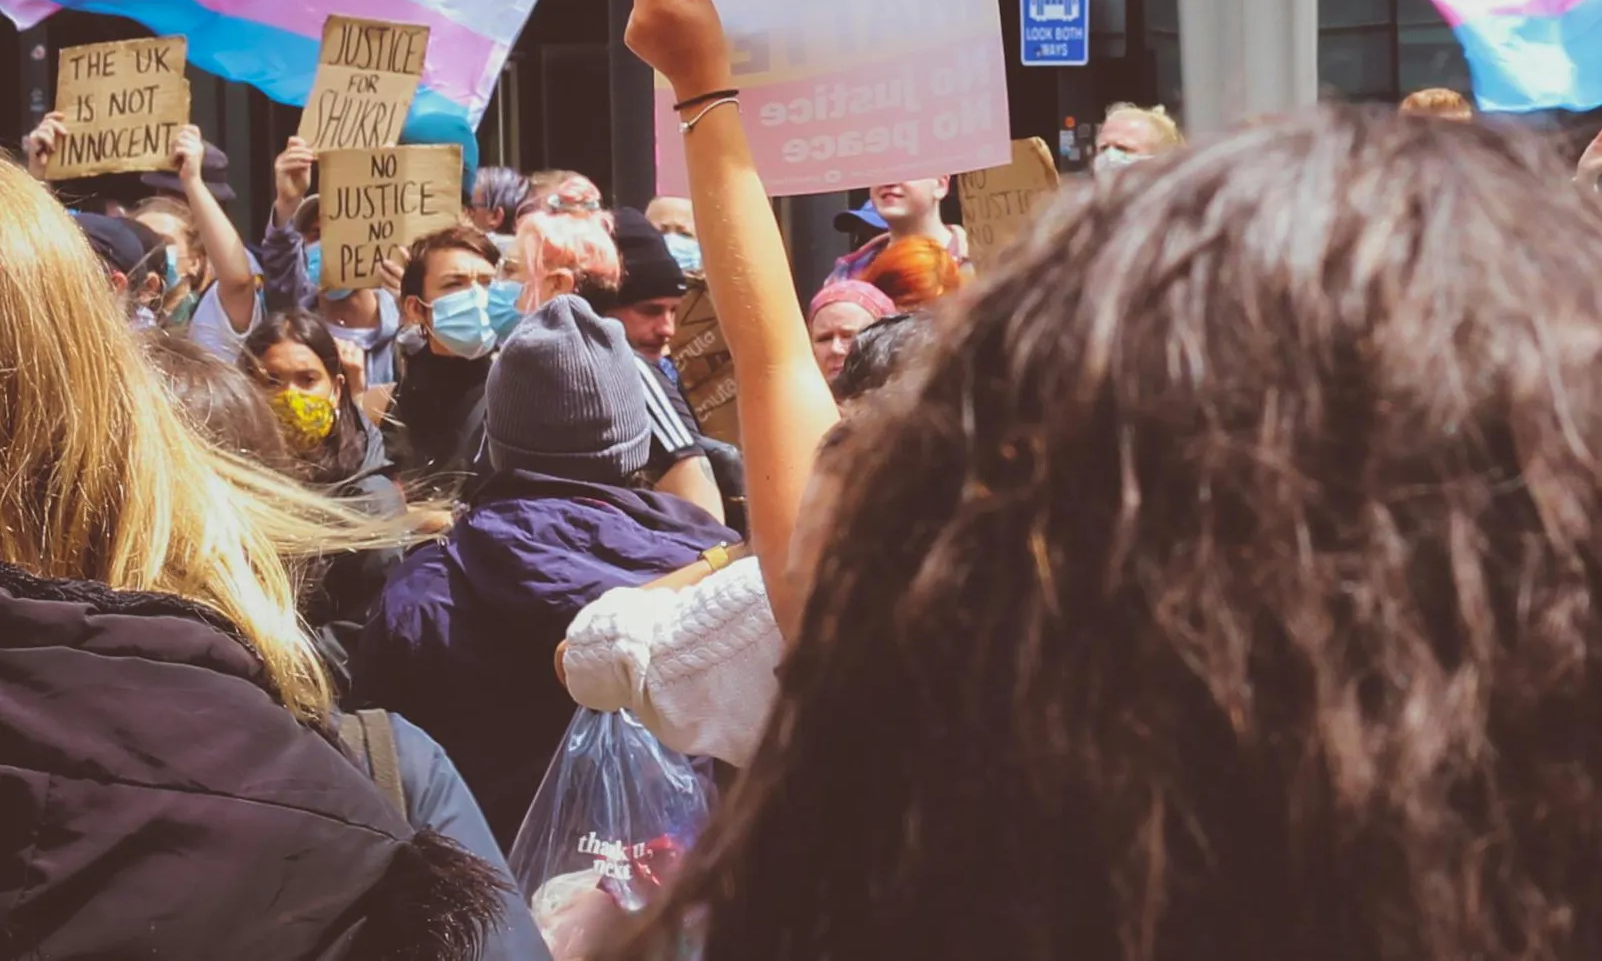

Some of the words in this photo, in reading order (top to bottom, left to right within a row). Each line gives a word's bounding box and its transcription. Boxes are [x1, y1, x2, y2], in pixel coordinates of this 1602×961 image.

[1026, 27, 1053, 40] LOOK
[1055, 26, 1084, 40] BOTH
[70, 50, 116, 80] THE
[135, 47, 171, 73] UK
[329, 24, 421, 75] JUSTICE
[1040, 43, 1068, 56] WAYS
[348, 73, 380, 94] FOR
[76, 94, 95, 123] IS
[108, 85, 159, 117] NOT
[309, 89, 398, 149] SHUKRI
[59, 122, 178, 166] INNOCENT
[371, 154, 397, 178] NO
[329, 180, 438, 220] JUSTICE
[368, 220, 394, 242] NO
[577, 831, 630, 861] thank
